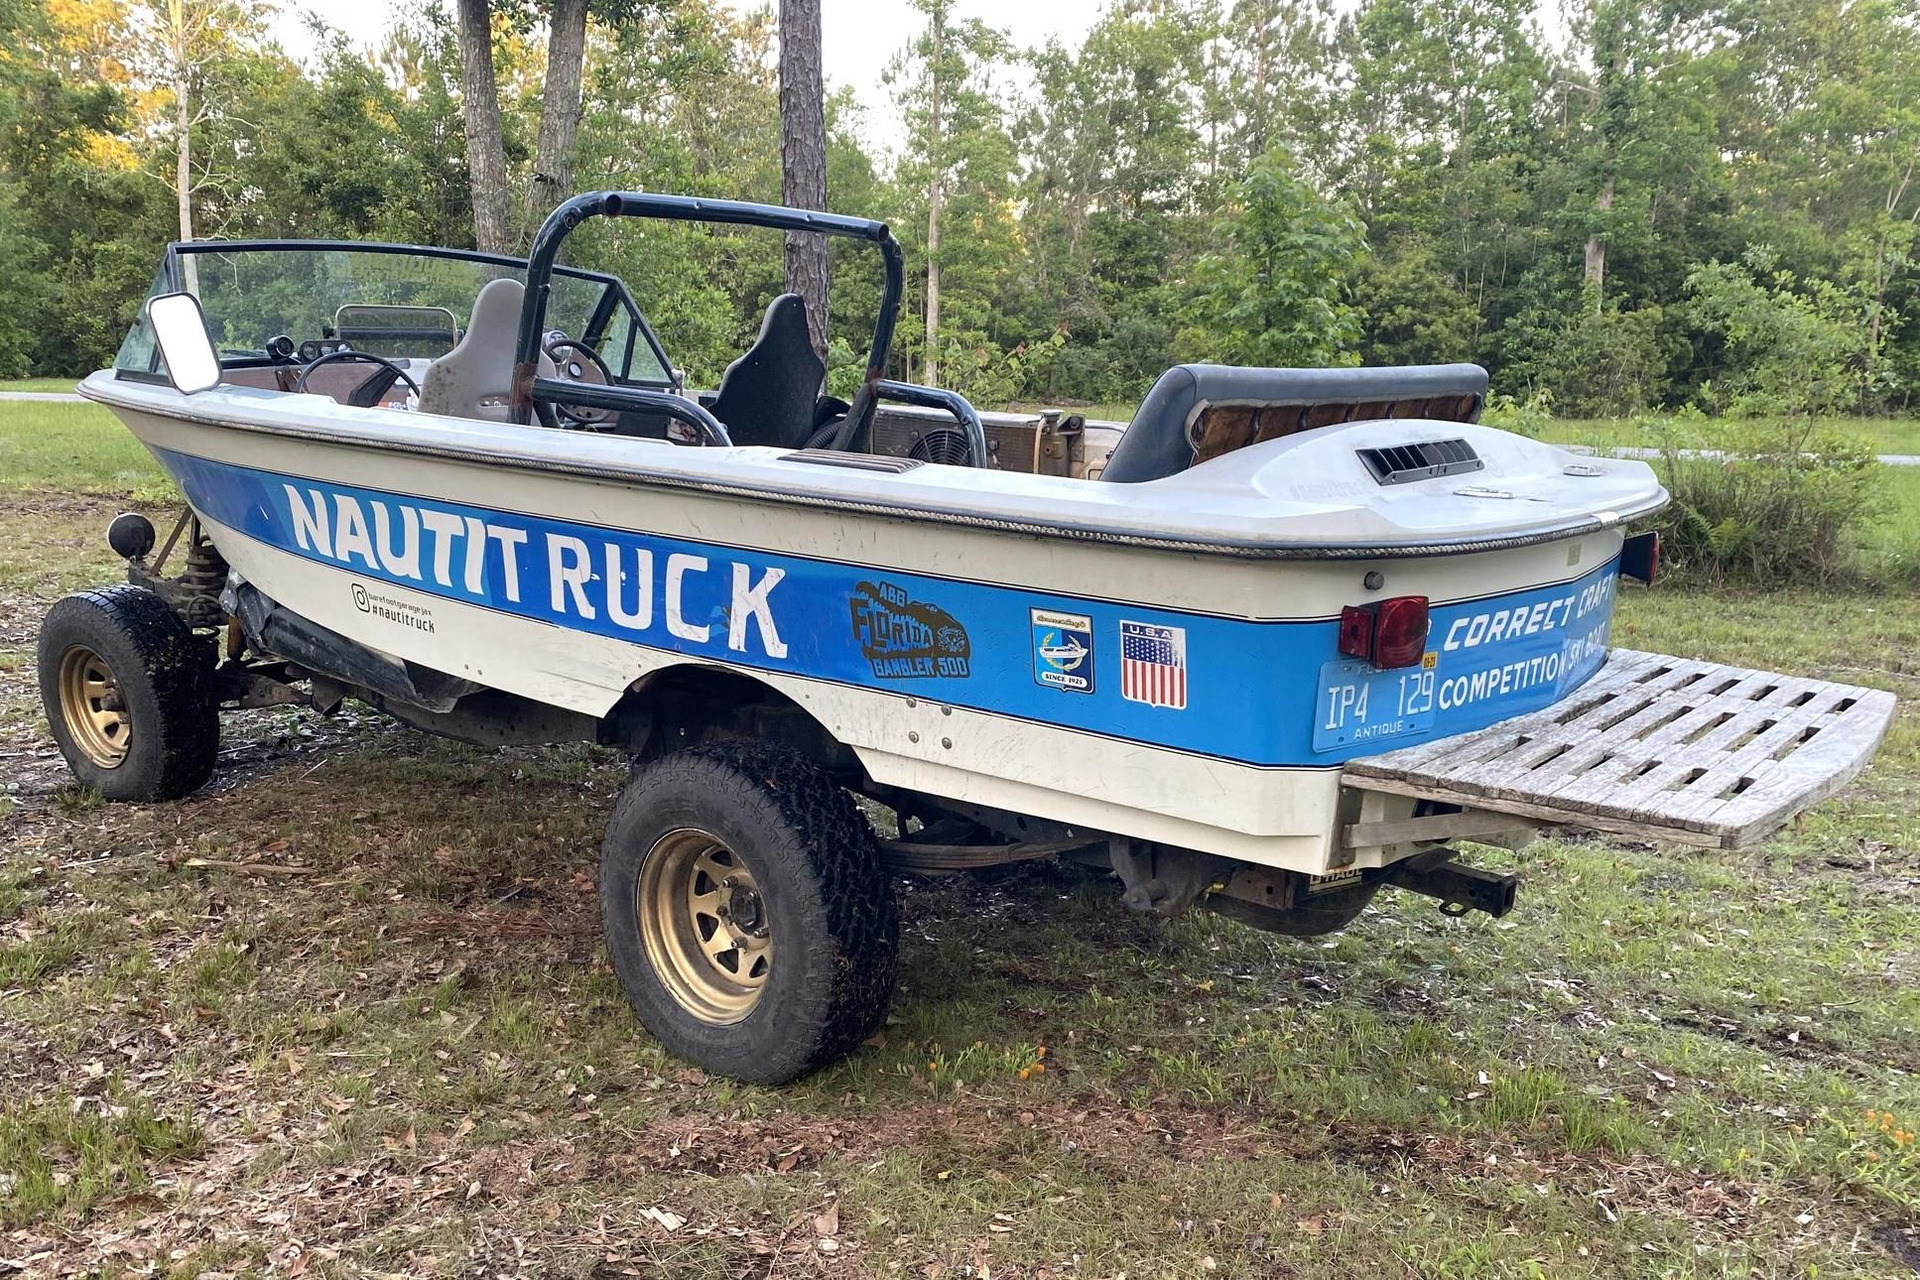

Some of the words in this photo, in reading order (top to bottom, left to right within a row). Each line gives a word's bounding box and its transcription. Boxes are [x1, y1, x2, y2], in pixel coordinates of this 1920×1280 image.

[373, 605, 436, 634] #nautitruck
[851, 597, 935, 648] FLORIDA
[1443, 595, 1576, 651] CORRECT
[1577, 571, 1612, 619] CRAFT
[873, 657, 935, 677] GAMBLER
[937, 657, 968, 677] 500
[1044, 673, 1067, 683] SINCE
[1068, 676, 1084, 686] 1925
[1438, 649, 1568, 710] COMPETITION
[1568, 637, 1586, 670] SKI
[1325, 682, 1370, 731] IP4
[1397, 671, 1435, 717] 129
[1353, 720, 1404, 739] ANTIQUE
